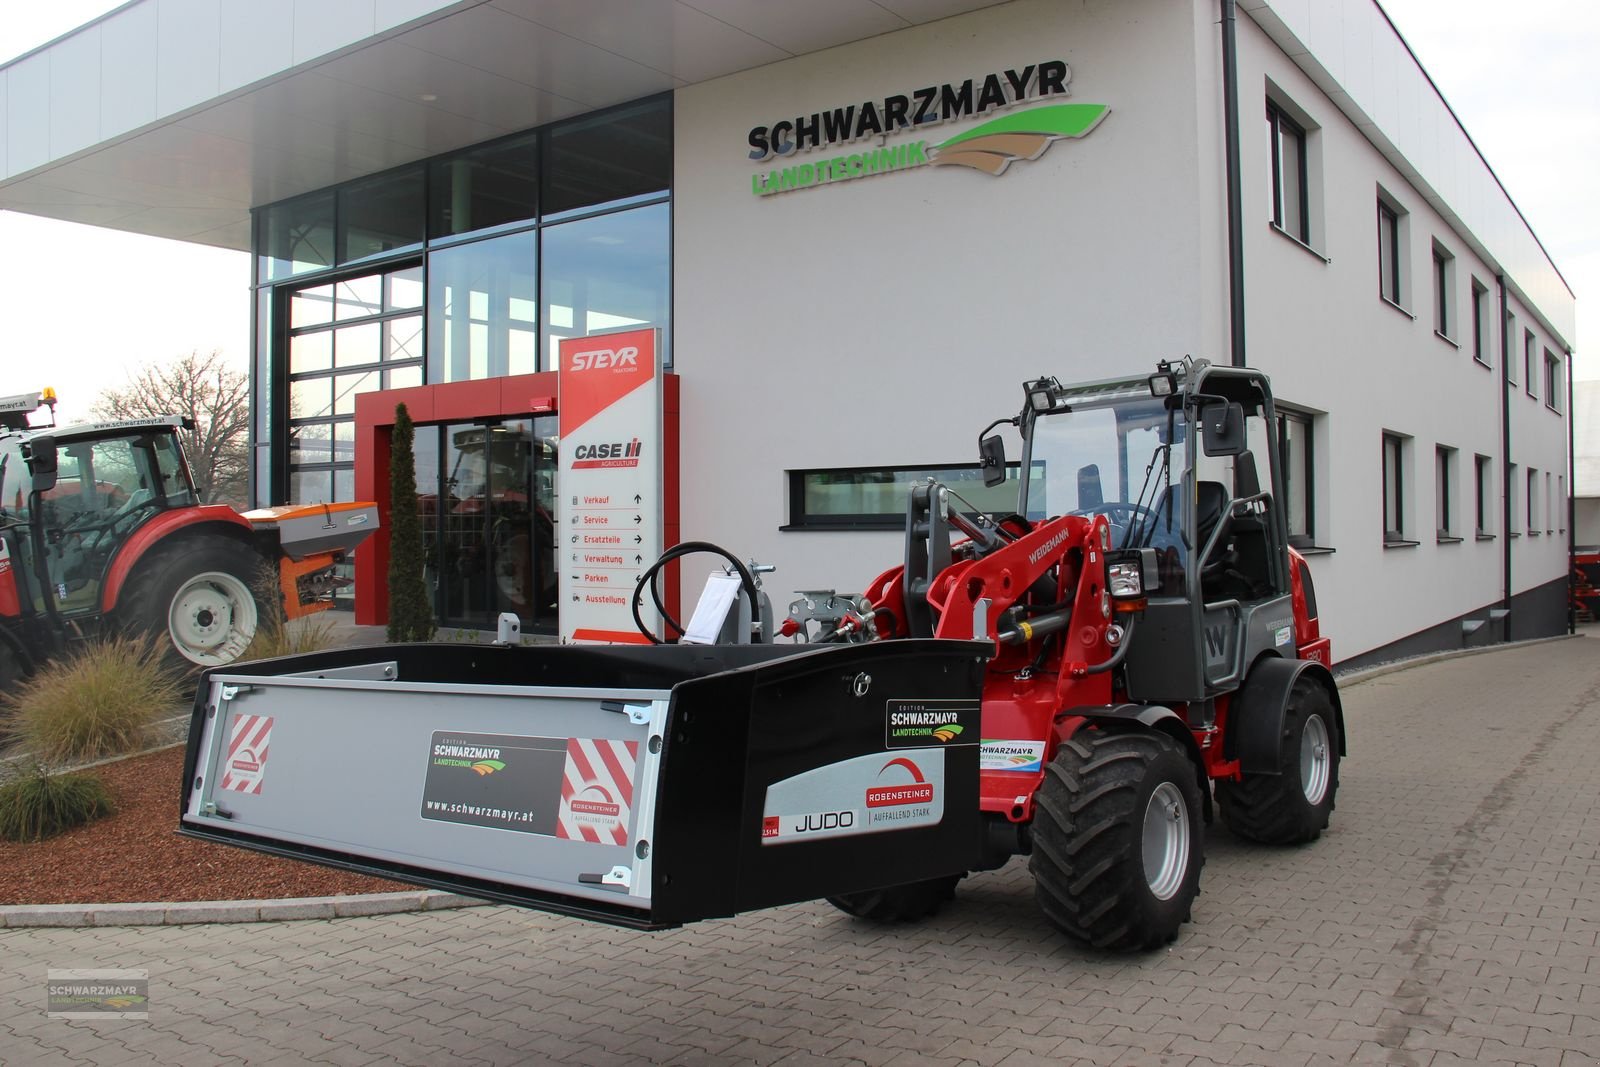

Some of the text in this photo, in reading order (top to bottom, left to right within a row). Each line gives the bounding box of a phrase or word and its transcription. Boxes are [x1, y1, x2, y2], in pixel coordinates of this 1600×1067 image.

[748, 60, 1071, 160] SCHWARZMAYR
[752, 140, 929, 197] LANDTECHNIK
[570, 346, 638, 372] STEYR
[94, 418, 166, 429] www.schwarzmayr.at
[575, 444, 622, 459] CASE
[601, 459, 637, 467] AGRICULTURE
[584, 495, 610, 504] Verkauf
[584, 516, 608, 524] Service
[584, 535, 621, 544] Ersatzteile
[1029, 528, 1069, 564] WEIDEMANN
[584, 554, 623, 564] Verwaltung
[585, 574, 609, 582] Parken
[585, 595, 626, 605] Ausstellung
[891, 712, 958, 725] SCHWARZMAYR
[892, 727, 933, 737] LANDTECHNIK
[434, 744, 500, 760] SCHWARZMAYR
[434, 758, 472, 768] LANDTECHNIK
[868, 789, 930, 802] ROSENSTEINER
[427, 800, 534, 823] www.schwarzmayr.at
[572, 803, 618, 814] ROSENSTEINER
[795, 811, 854, 832] JUDO
[873, 808, 931, 823] AUFFALLEND STARK
